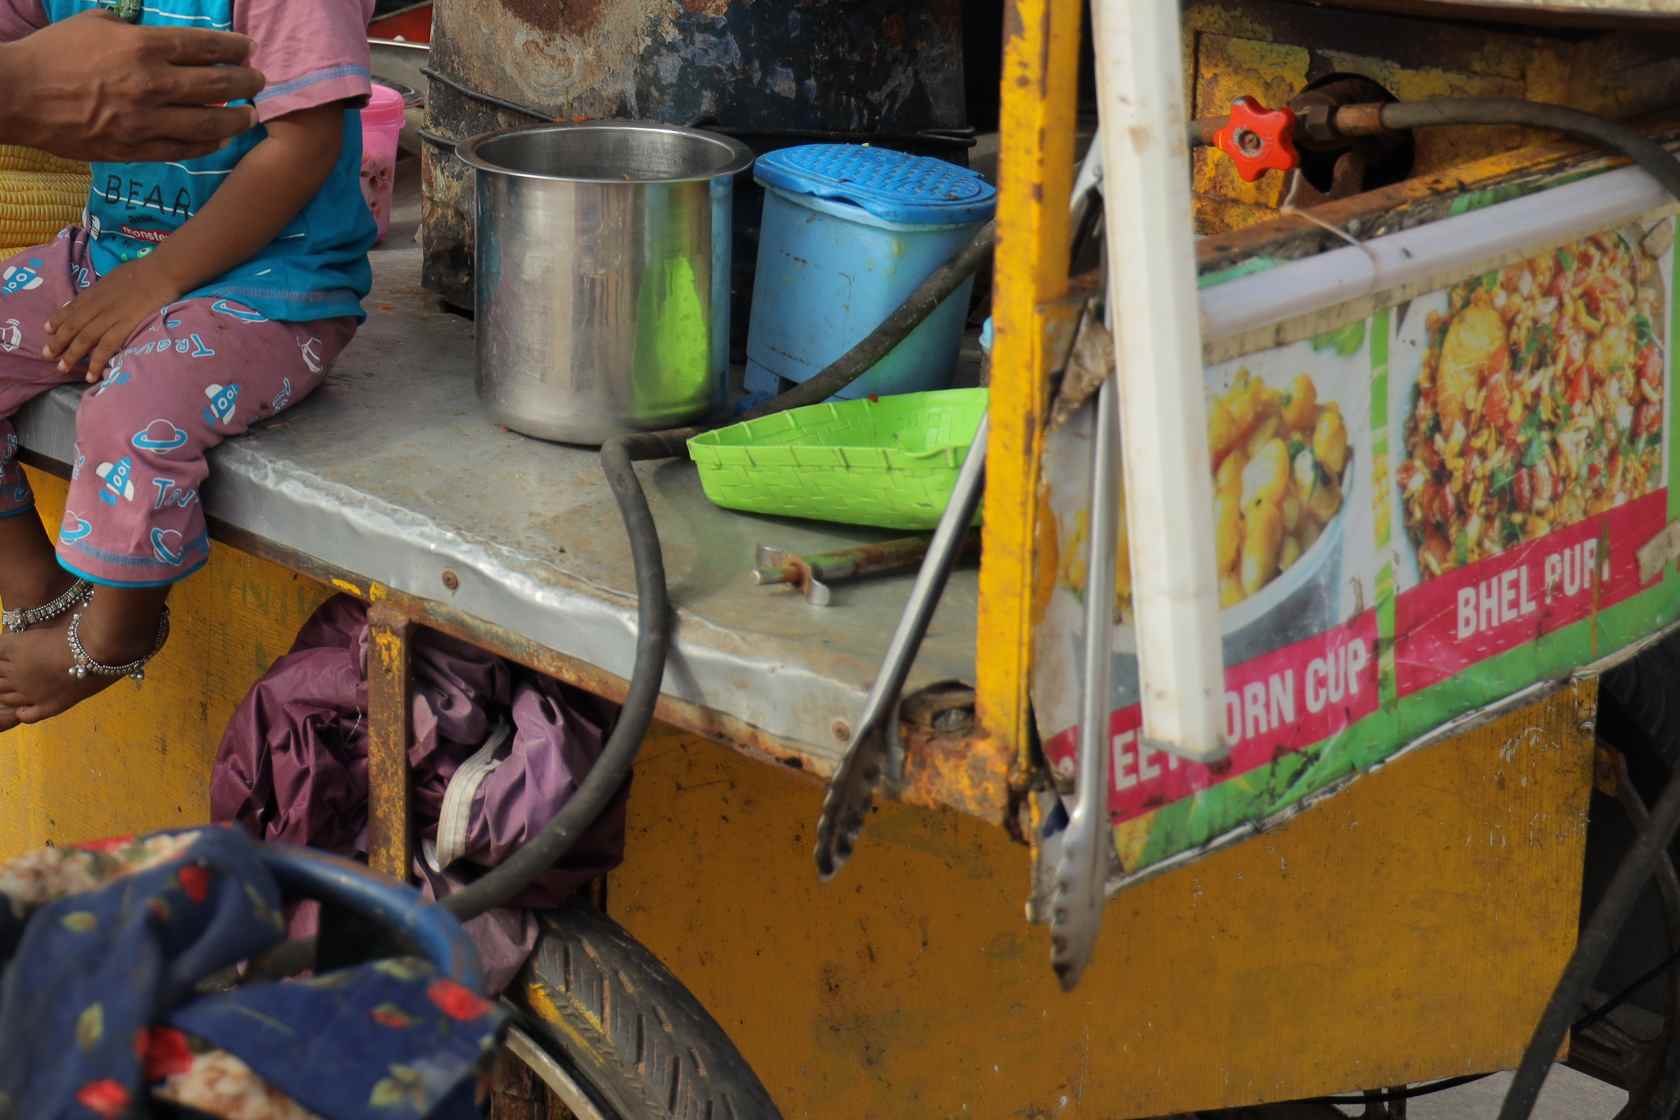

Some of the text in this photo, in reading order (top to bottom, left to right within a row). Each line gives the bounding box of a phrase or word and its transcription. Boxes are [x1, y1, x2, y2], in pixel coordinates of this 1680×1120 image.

[1456, 565, 1537, 641] BHEL
[1223, 638, 1367, 747] ORN CUP
